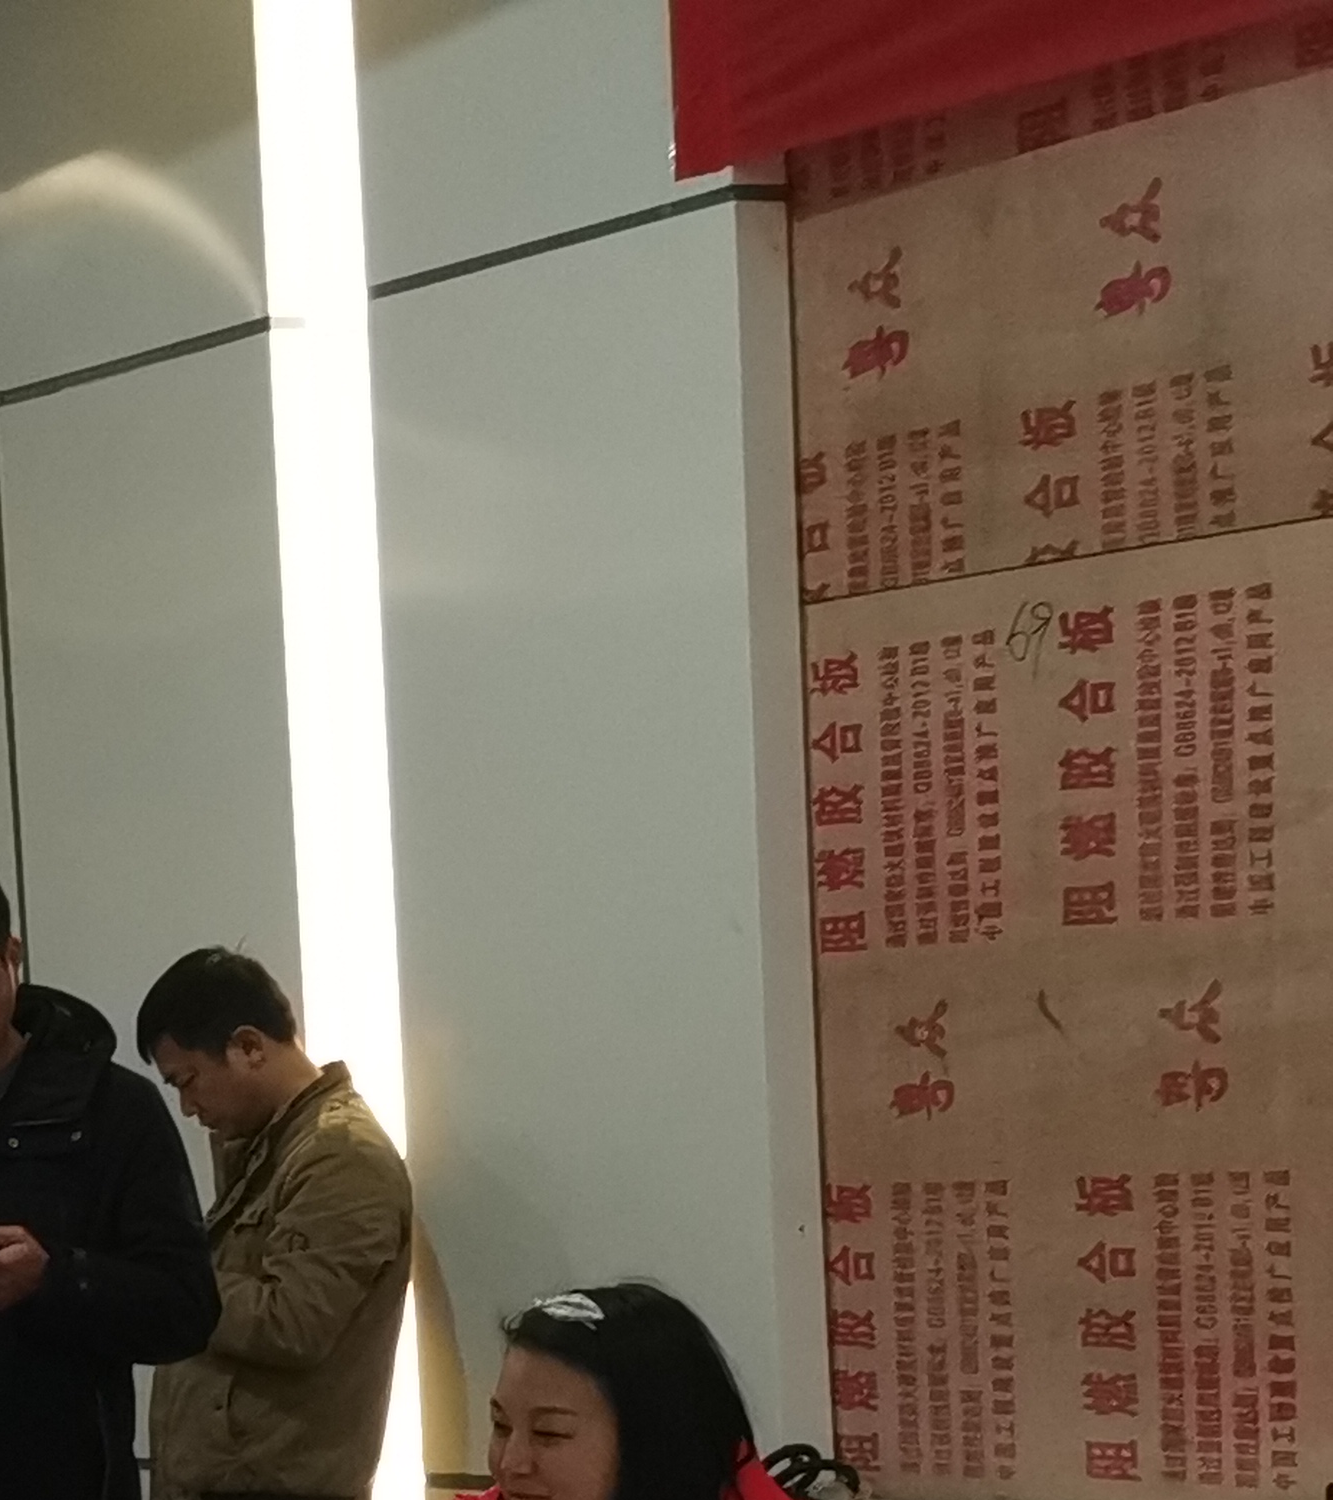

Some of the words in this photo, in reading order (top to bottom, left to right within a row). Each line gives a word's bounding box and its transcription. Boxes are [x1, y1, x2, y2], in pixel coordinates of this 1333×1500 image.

[810, 649, 869, 956] 阻燃胶合板
[1057, 605, 1119, 927] 阻燃胶合板
[825, 1180, 881, 1474] 阻燃胶合板
[1074, 1172, 1142, 1483] 阻燃胶合板
